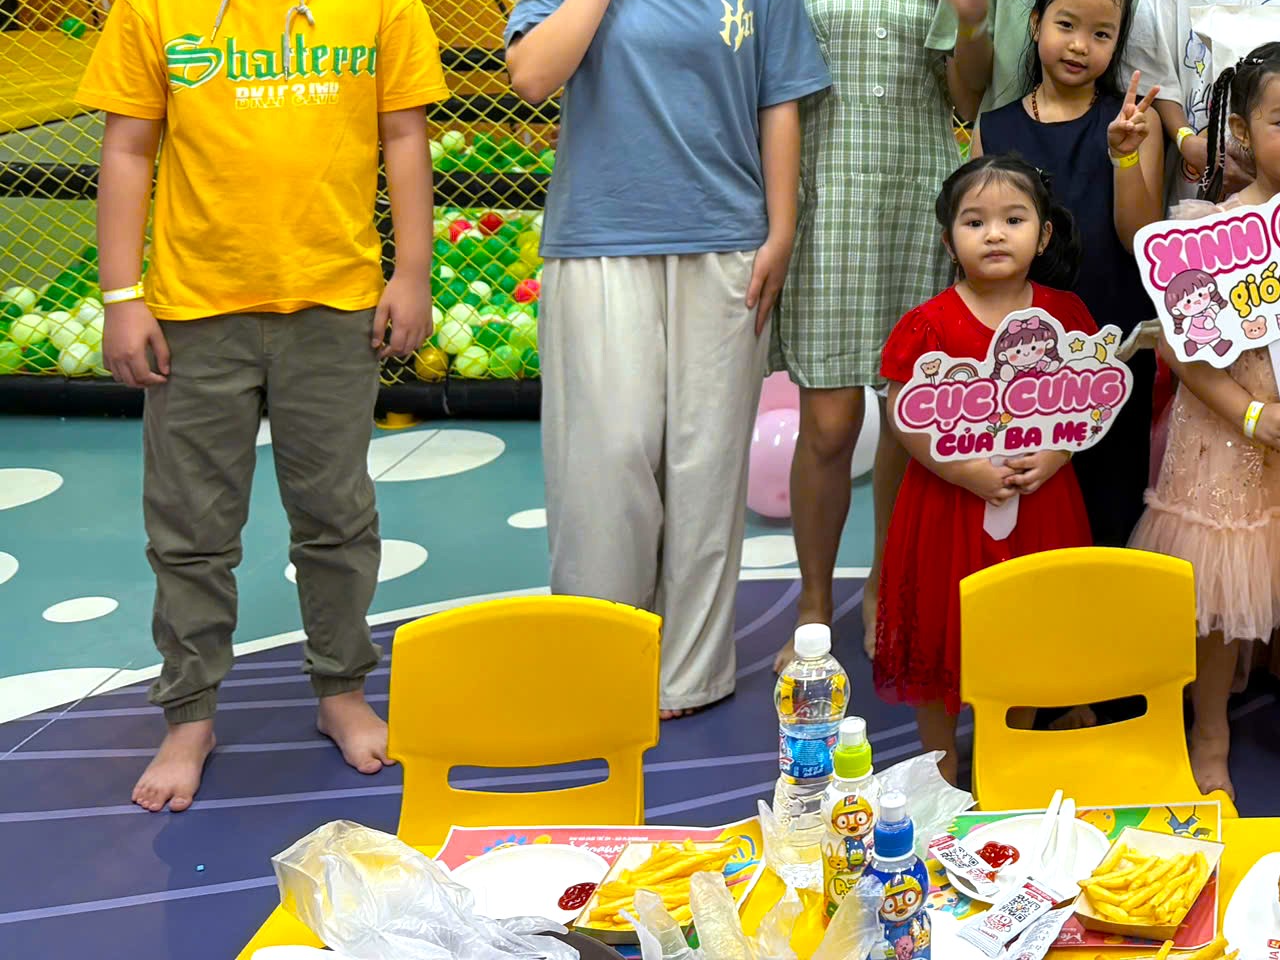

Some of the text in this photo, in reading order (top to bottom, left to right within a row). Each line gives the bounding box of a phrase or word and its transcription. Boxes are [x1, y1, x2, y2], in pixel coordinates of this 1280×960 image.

[1147, 216, 1267, 287] XINH
[902, 368, 1124, 430] CỤC CƯNG
[935, 420, 1089, 457] CỦA BA MẸ
